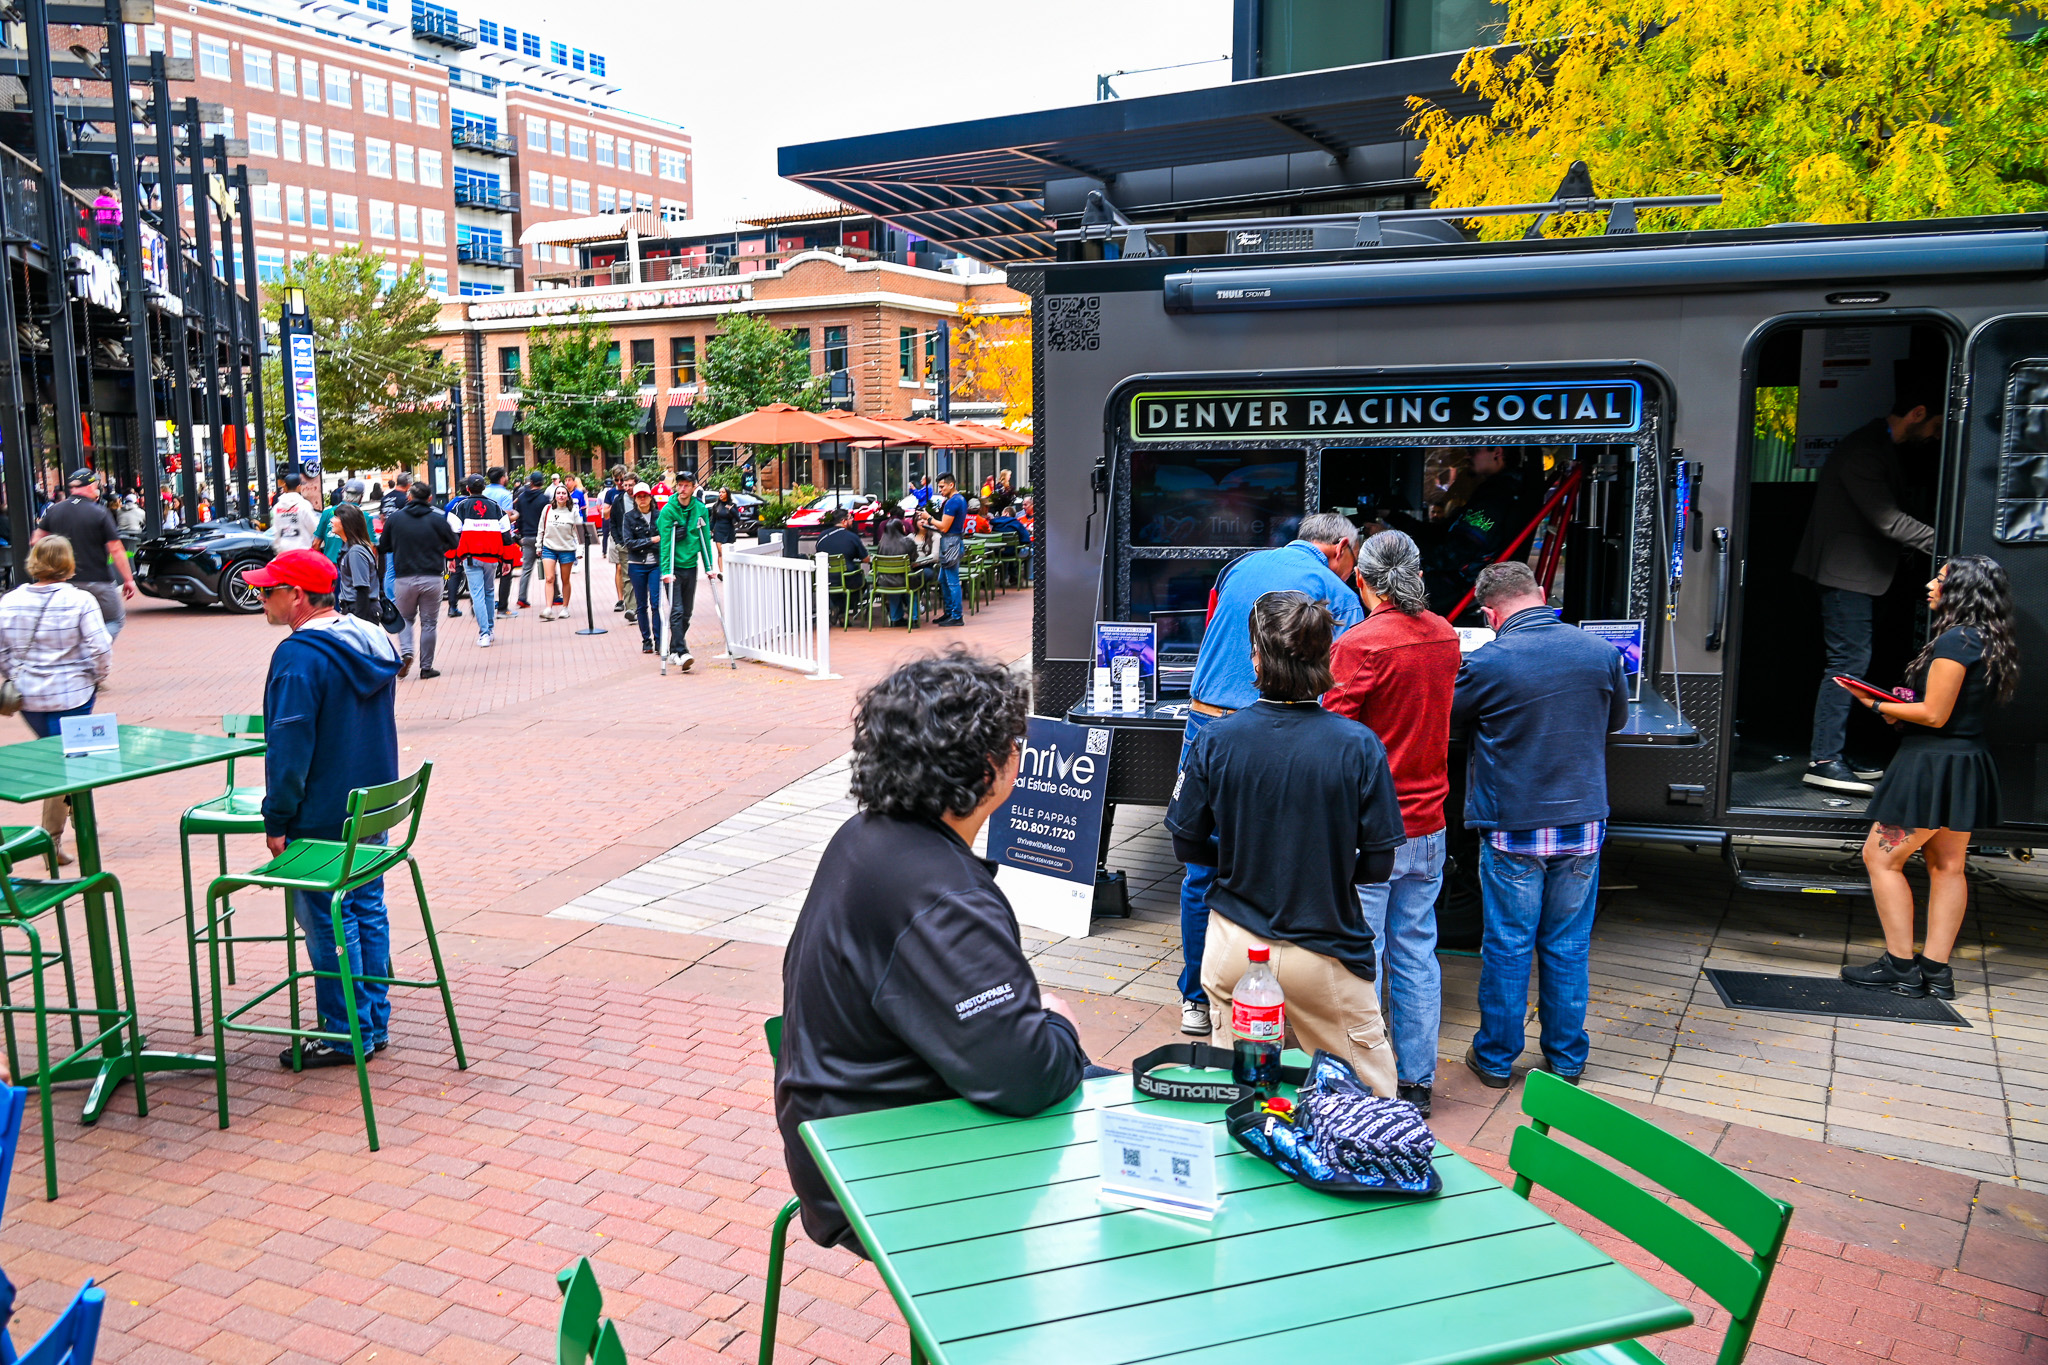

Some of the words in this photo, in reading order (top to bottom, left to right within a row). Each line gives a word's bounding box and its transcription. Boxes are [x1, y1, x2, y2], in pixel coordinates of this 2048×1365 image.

[1216, 289, 1243, 299] THULE
[1064, 319, 1083, 329] DRS
[1147, 401, 1289, 430] DENVER
[1308, 397, 1451, 425] RACING
[1472, 392, 1622, 422] SOCIAL
[1016, 738, 1095, 785] hrive
[1027, 777, 1058, 794] Estate
[1059, 783, 1092, 802] Group
[1011, 804, 1034, 820] ELLE
[1037, 809, 1078, 826] PAPPAS
[1010, 818, 1076, 841] 720.807.1720
[955, 983, 1013, 1013] UNSTOPPABLE
[1137, 1076, 1241, 1100] SUBTRONICS
